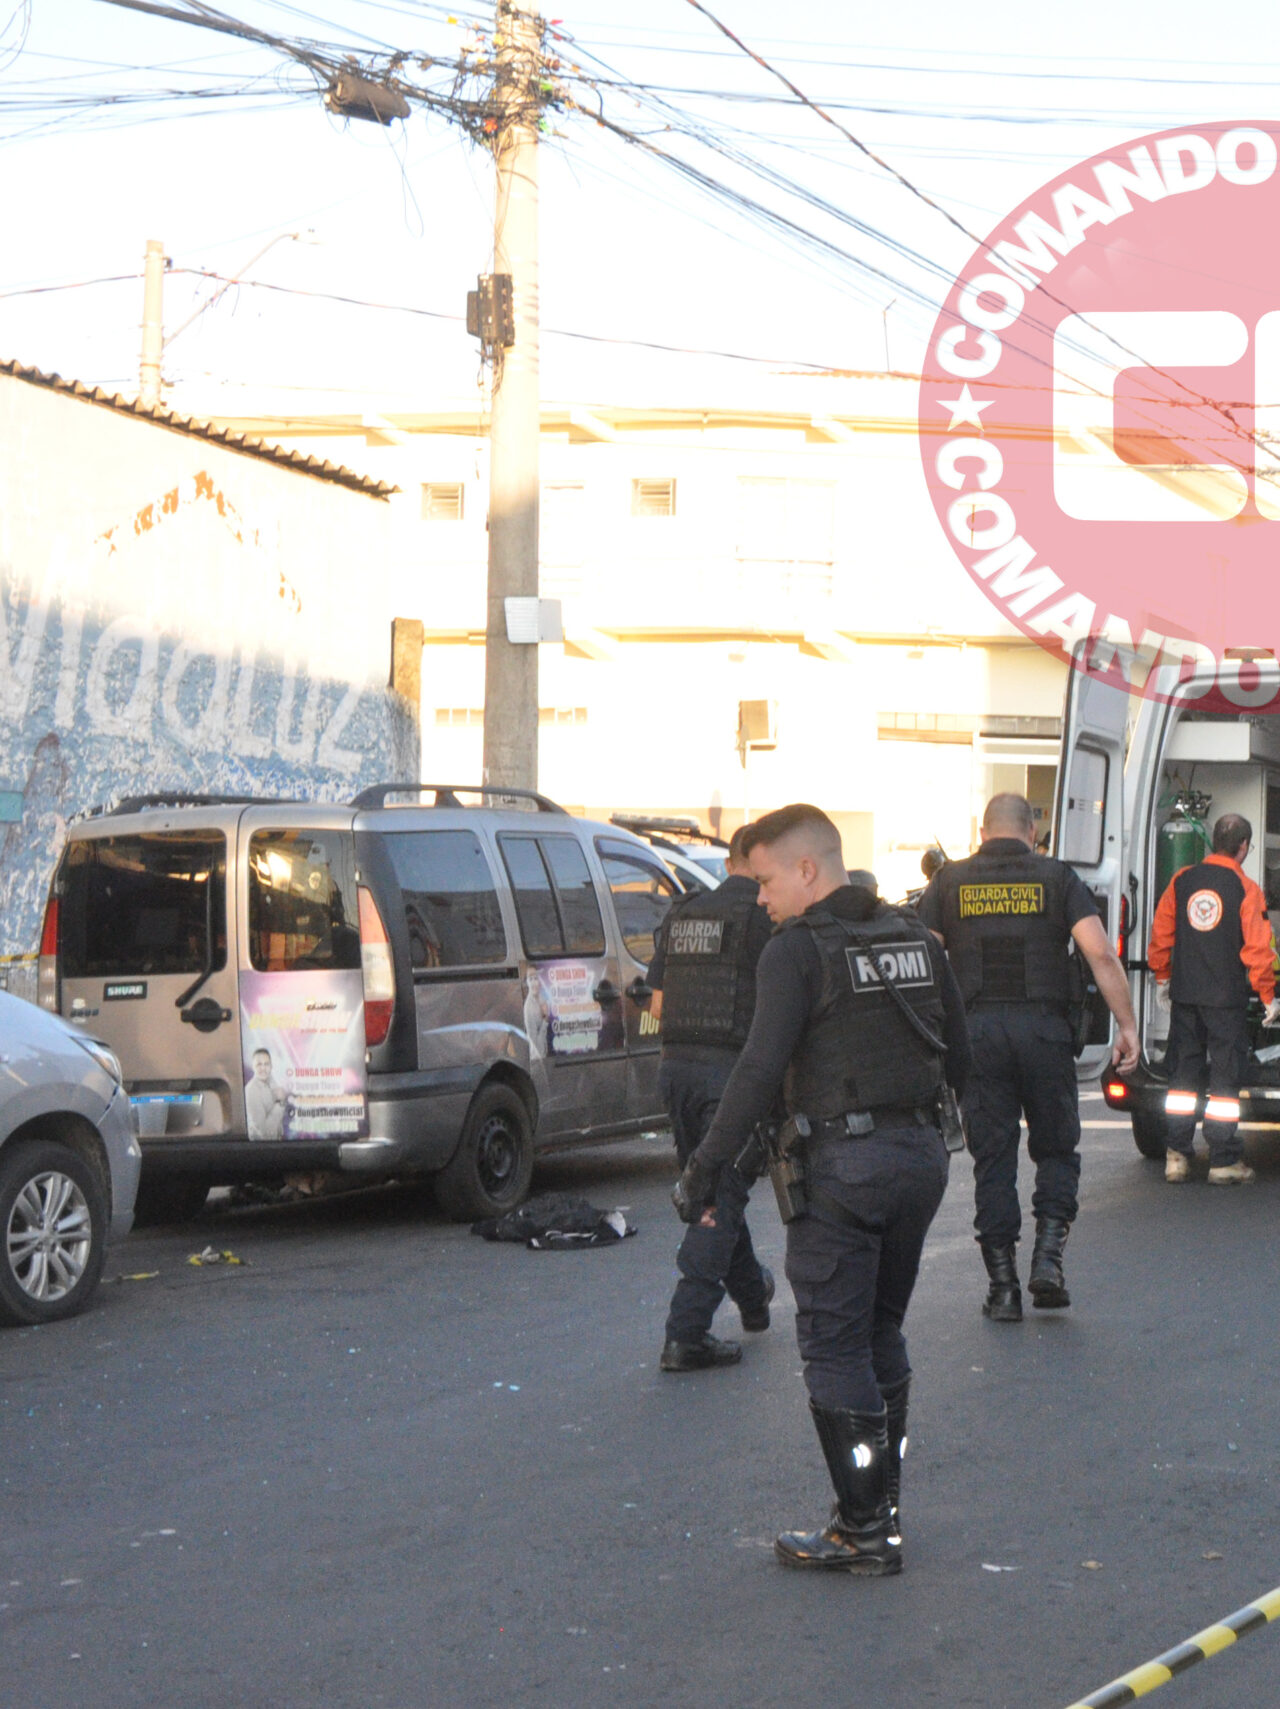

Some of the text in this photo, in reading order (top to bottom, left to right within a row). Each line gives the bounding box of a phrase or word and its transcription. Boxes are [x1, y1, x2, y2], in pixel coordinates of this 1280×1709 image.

[963, 887, 1038, 901] GUARDA CIVIL
[964, 901, 1038, 916] INDAIATUBA
[671, 921, 720, 953] GUARDA CIVIL
[856, 951, 928, 983] ROMI
